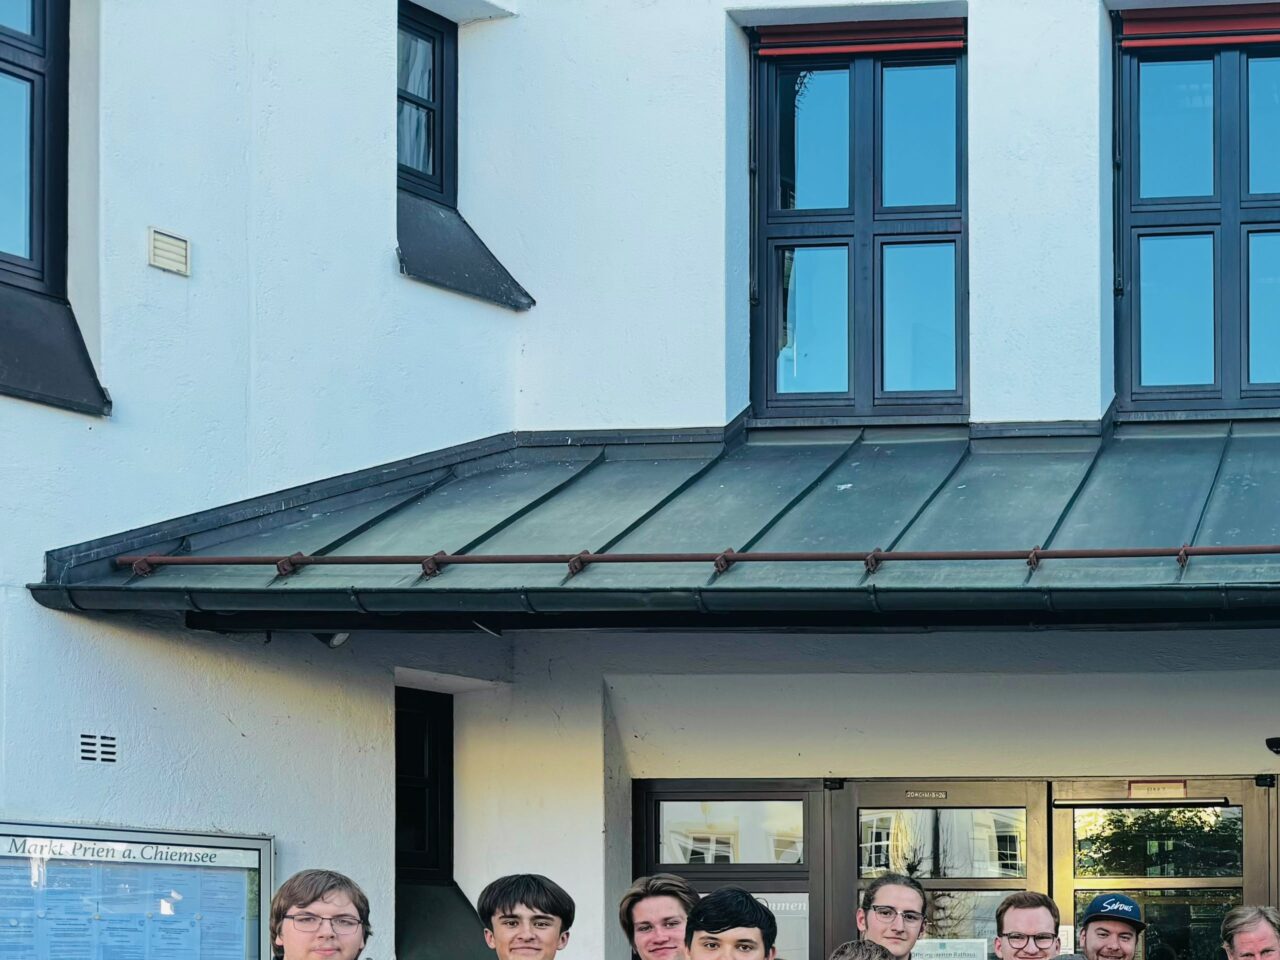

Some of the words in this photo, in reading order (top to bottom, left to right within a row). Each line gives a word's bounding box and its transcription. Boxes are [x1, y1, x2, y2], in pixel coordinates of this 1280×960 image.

[8, 838, 65, 856] Markt
[72, 842, 116, 859] Prien
[122, 848, 137, 859] a.
[140, 845, 217, 864] Chiemsee
